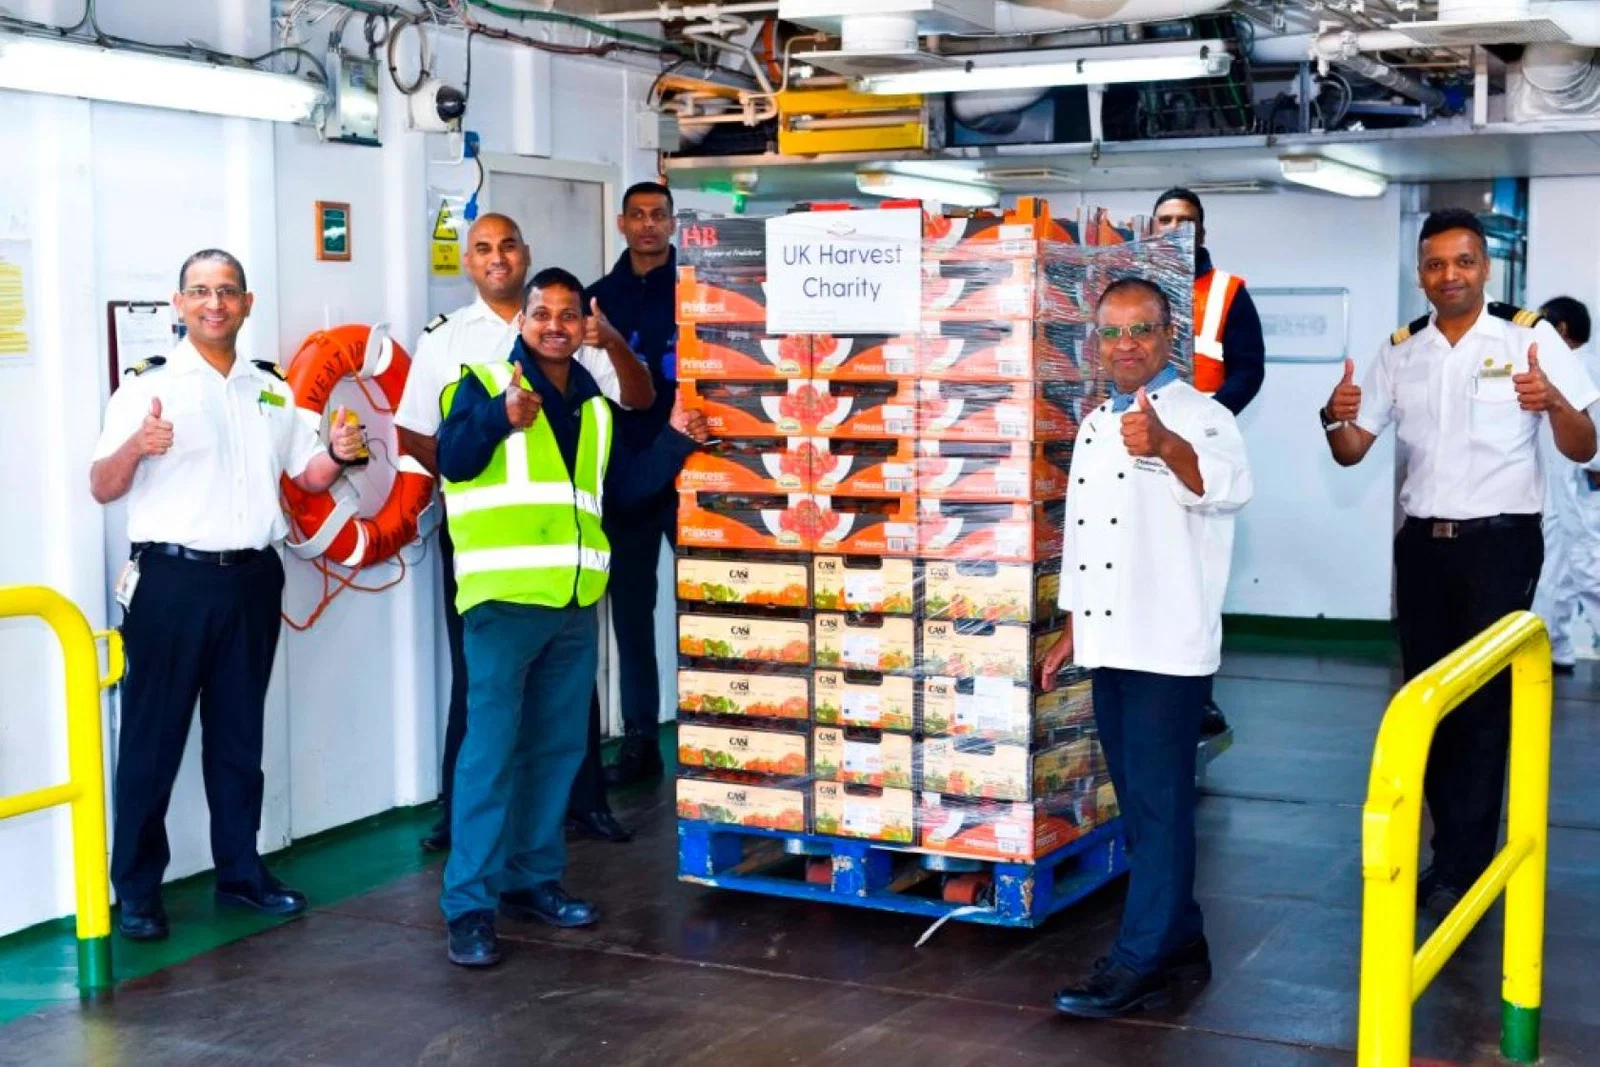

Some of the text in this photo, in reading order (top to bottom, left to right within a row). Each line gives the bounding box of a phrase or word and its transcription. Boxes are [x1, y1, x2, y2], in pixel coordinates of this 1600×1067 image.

[783, 244, 811, 265] UK
[820, 243, 902, 264] Harvest
[802, 277, 881, 302] Charity
